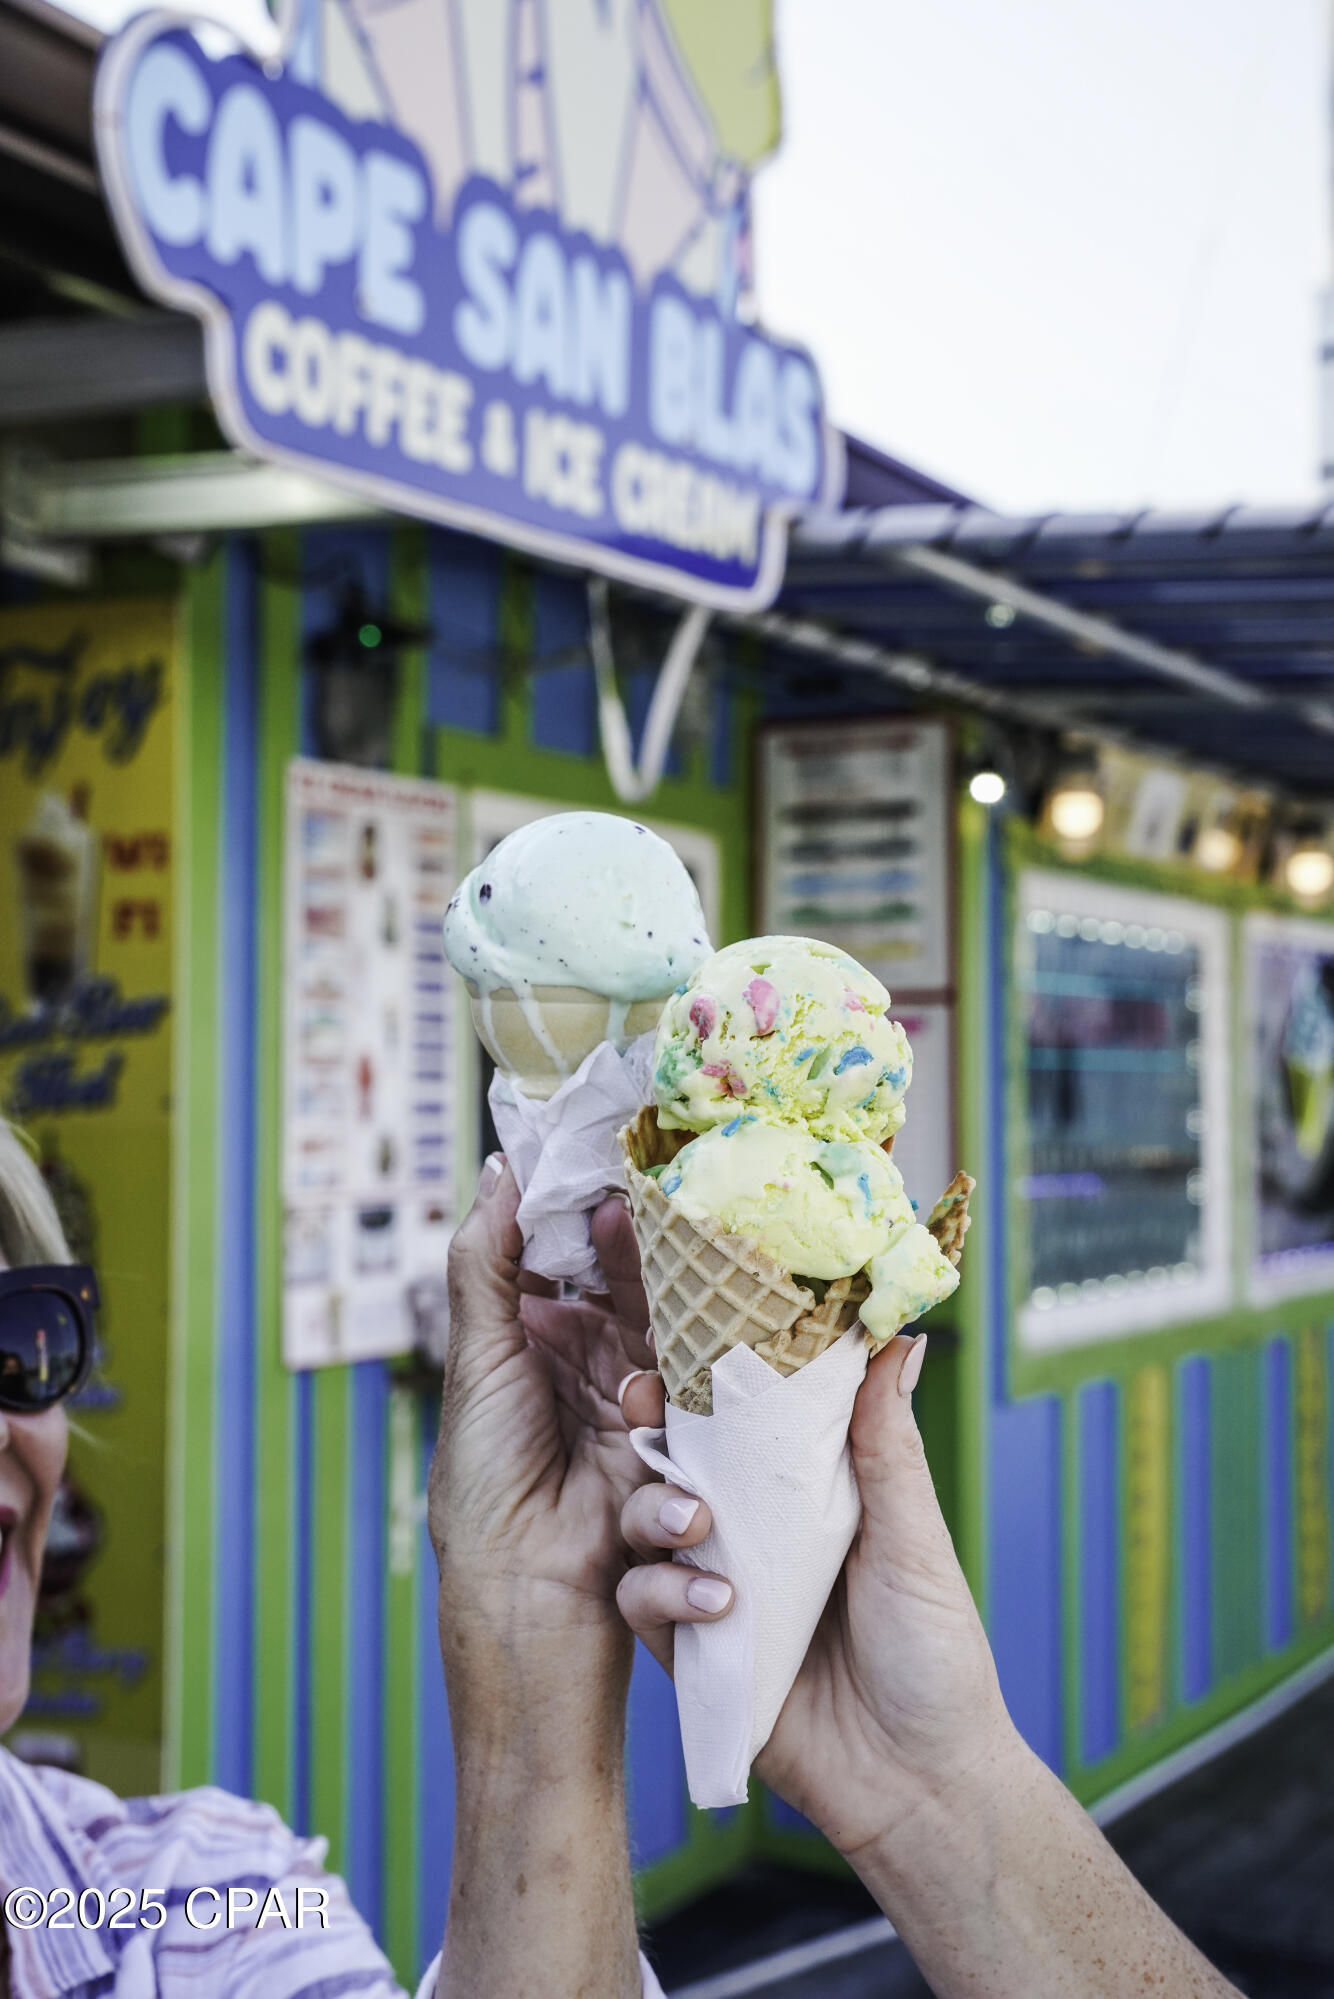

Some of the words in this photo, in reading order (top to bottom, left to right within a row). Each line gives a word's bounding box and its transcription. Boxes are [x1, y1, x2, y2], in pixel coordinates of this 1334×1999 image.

[122, 40, 426, 334] CAPE
[456, 202, 631, 418] SAN
[649, 292, 819, 498] BLAS
[244, 300, 474, 475] COFFEE
[482, 400, 519, 477] &
[523, 407, 606, 519] ICE
[611, 439, 761, 569] CREAM
